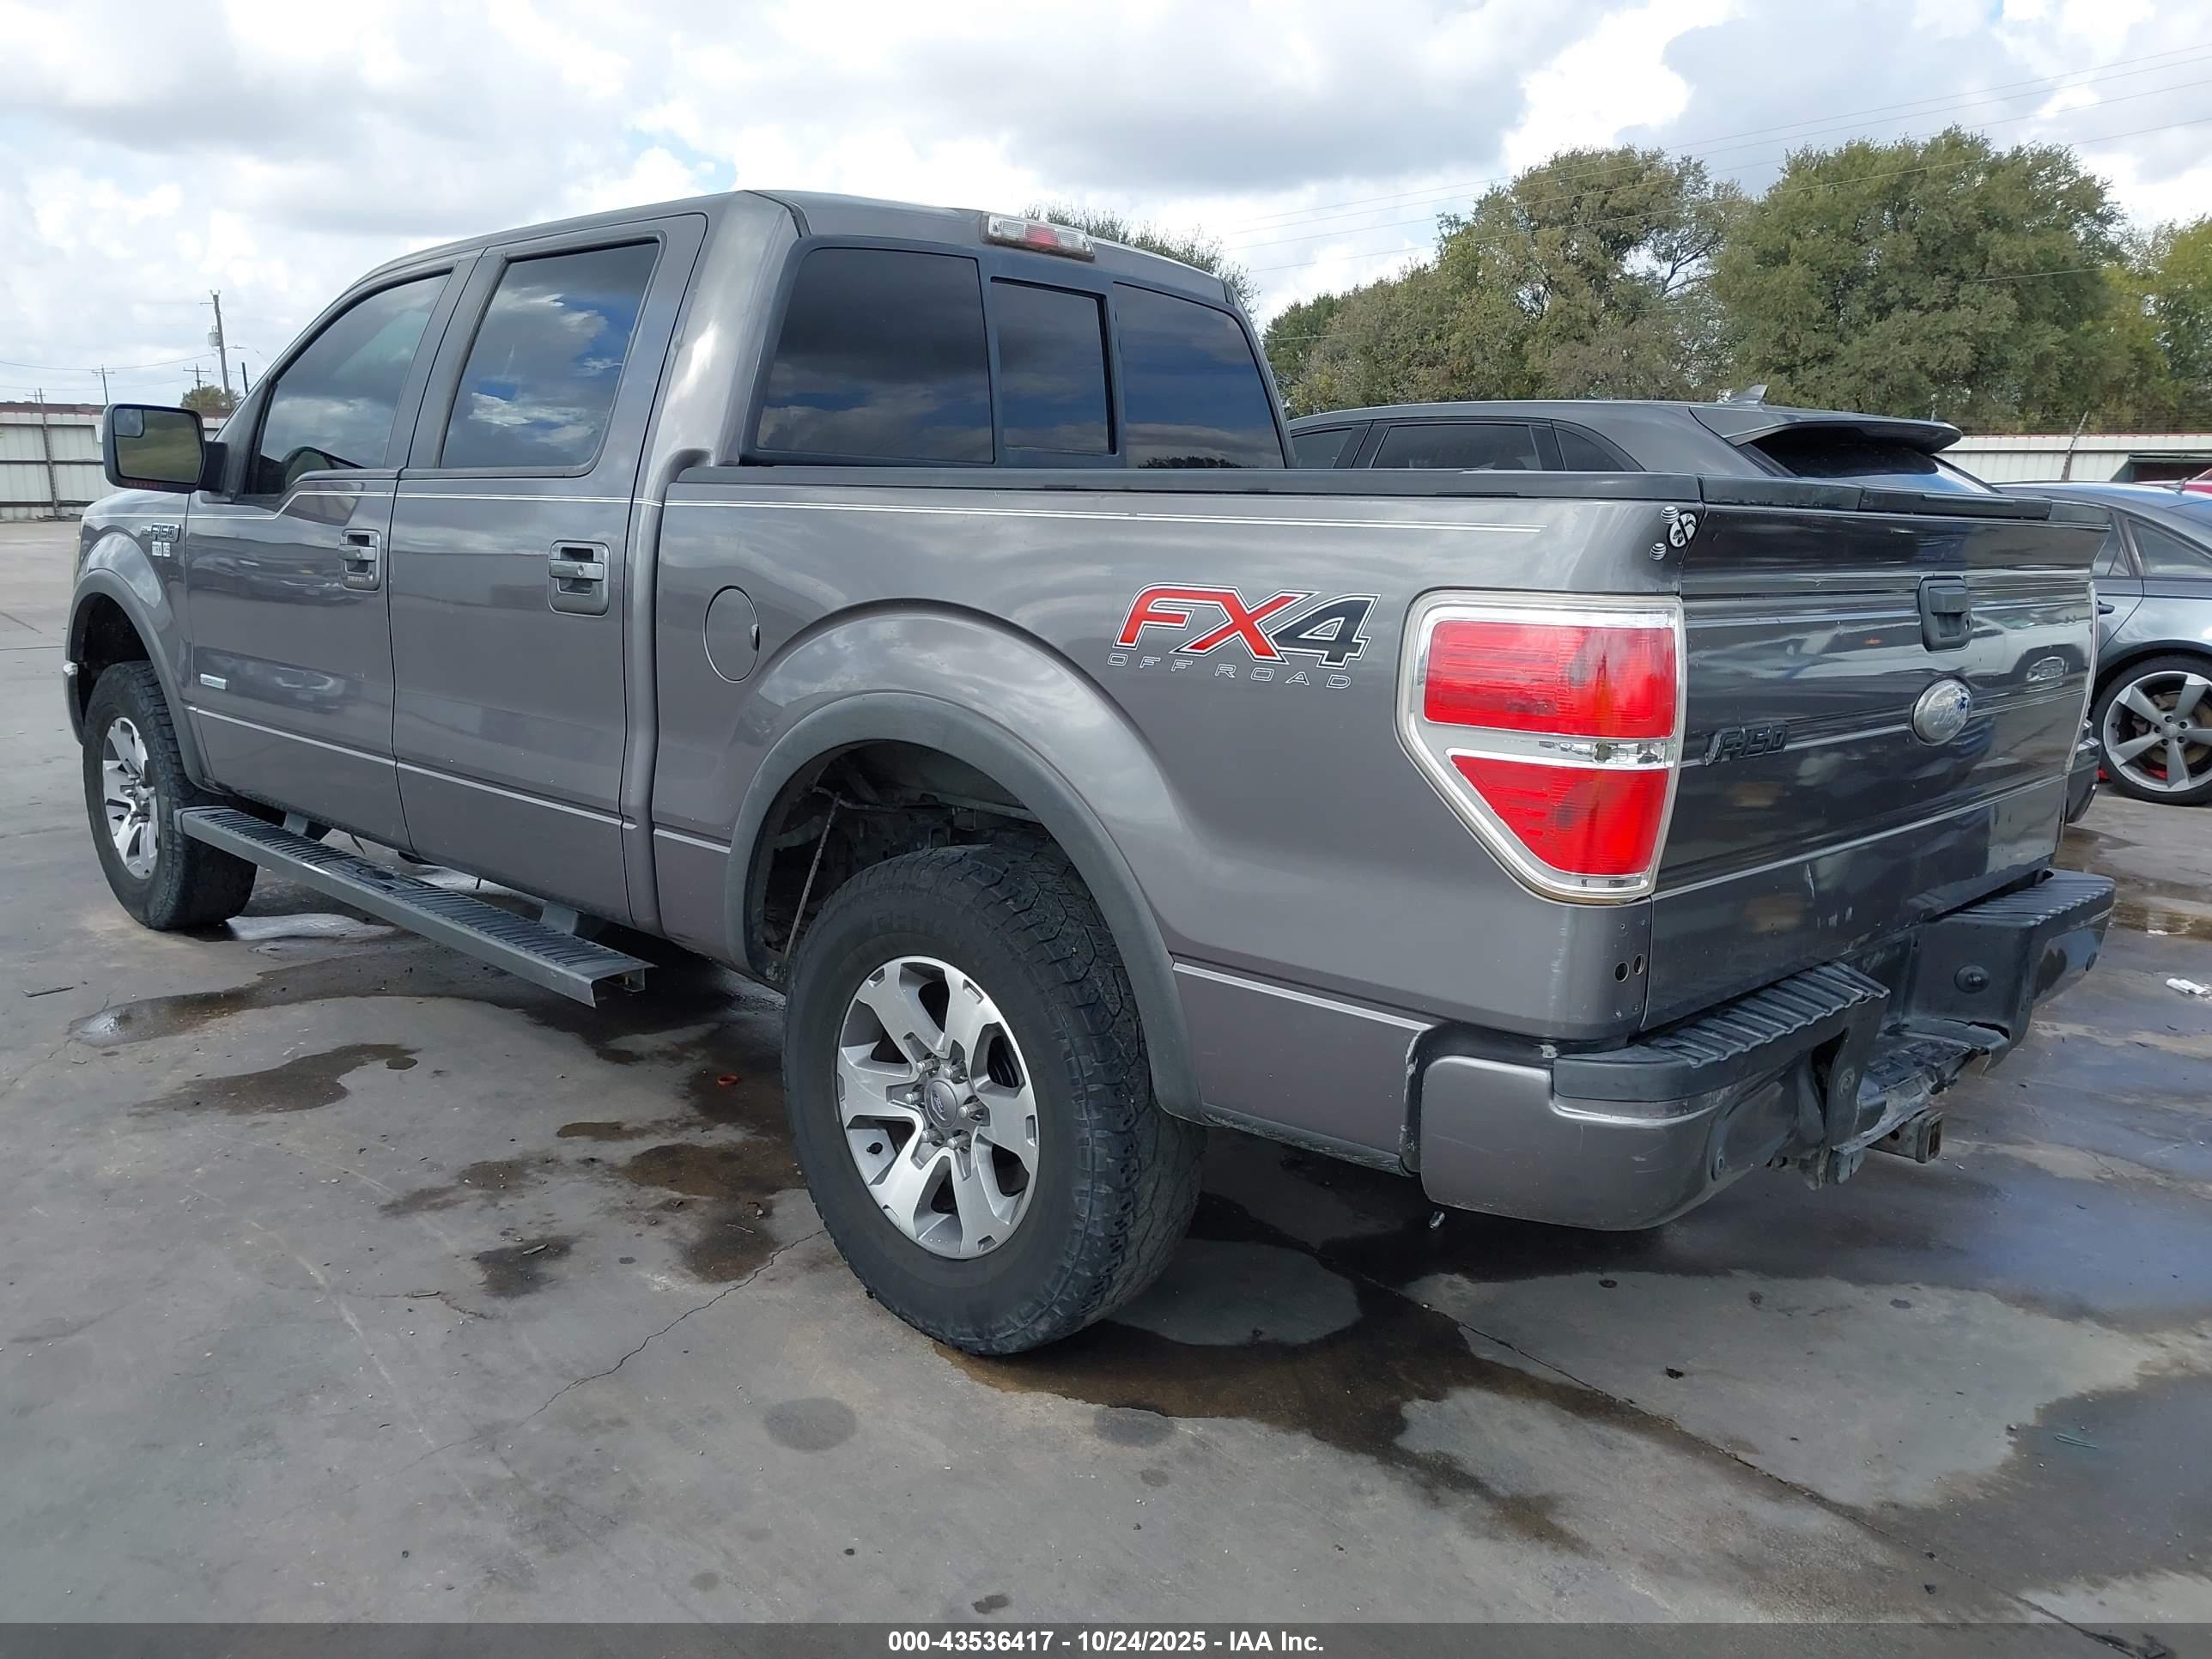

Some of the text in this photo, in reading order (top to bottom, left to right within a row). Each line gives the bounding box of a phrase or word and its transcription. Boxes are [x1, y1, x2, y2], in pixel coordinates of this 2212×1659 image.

[1112, 582, 1381, 670] FX4
[1107, 653, 1352, 690] OFF ROAD
